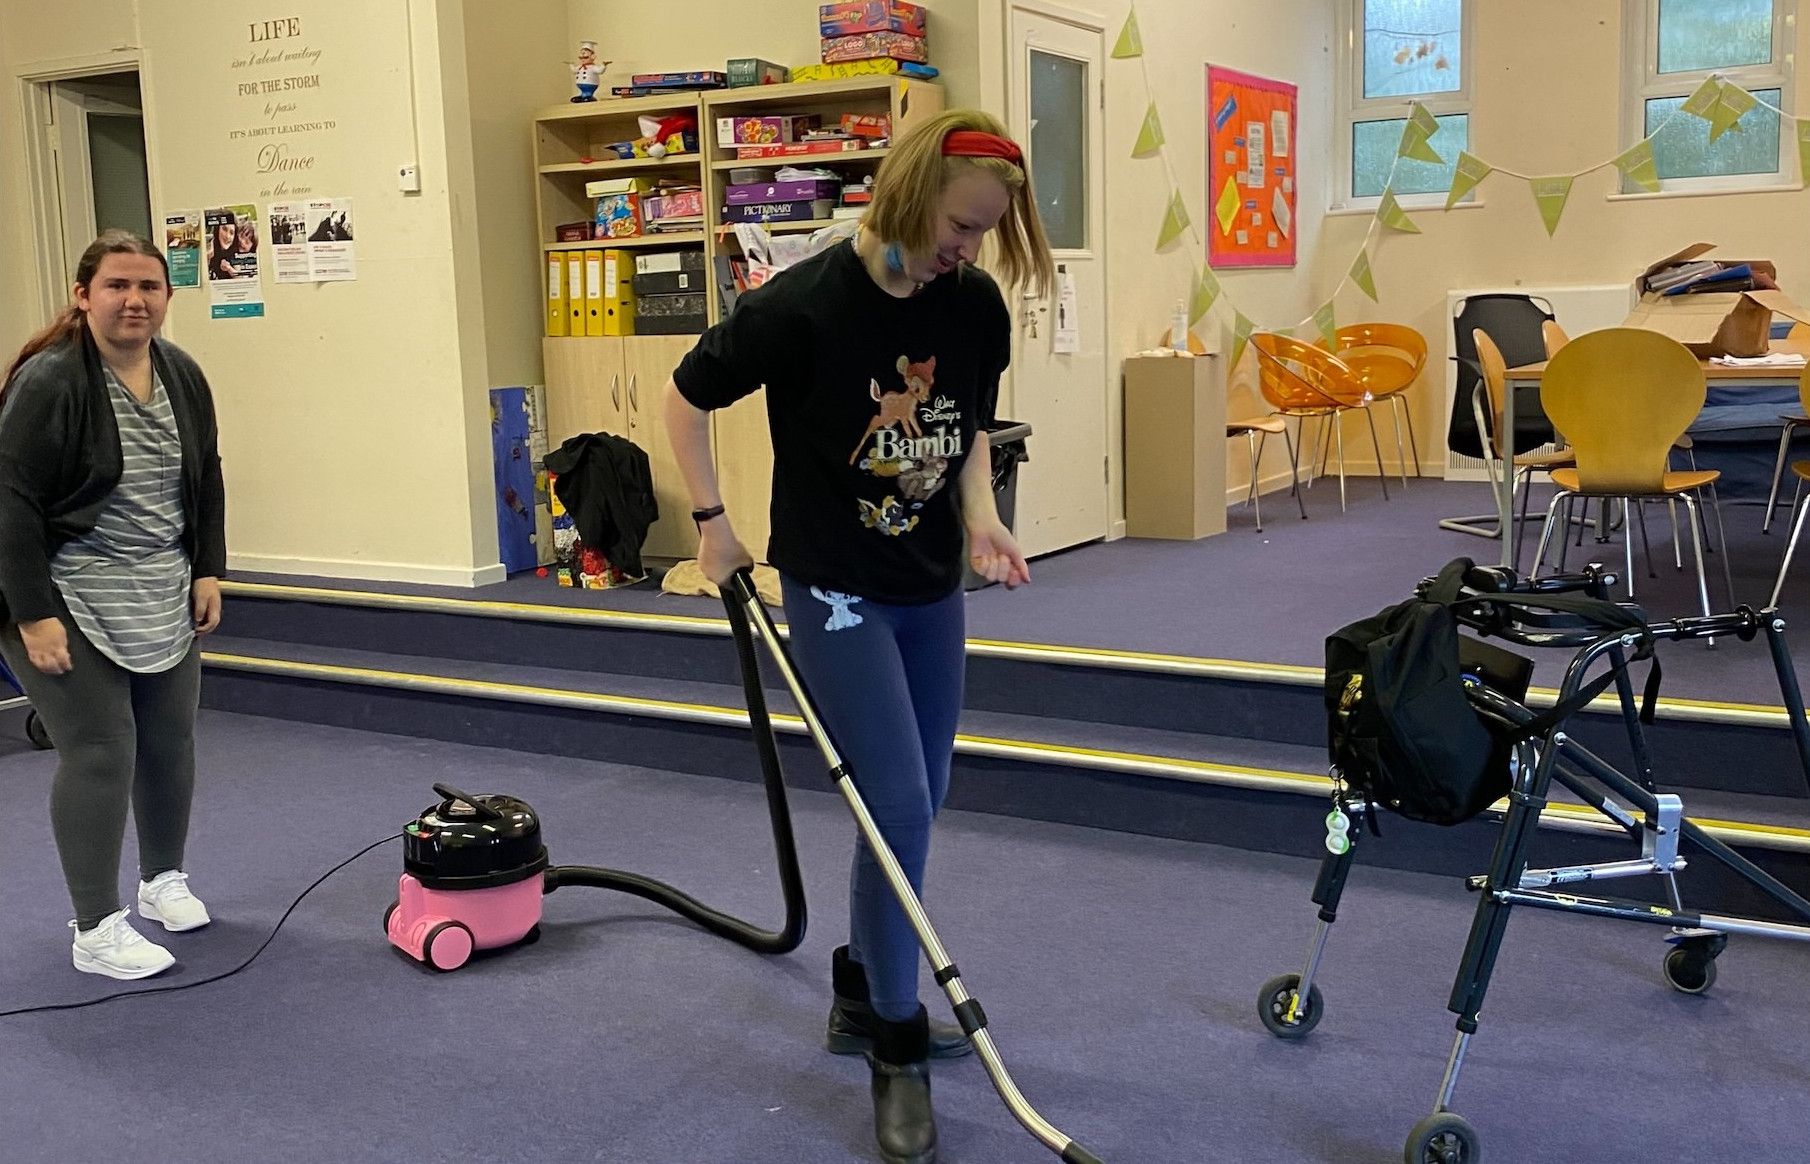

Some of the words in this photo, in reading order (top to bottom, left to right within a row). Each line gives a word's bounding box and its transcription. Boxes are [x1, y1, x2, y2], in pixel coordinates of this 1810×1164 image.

[248, 17, 300, 42] LIFE
[256, 48, 285, 65] about
[284, 46, 322, 67] waiting
[238, 82, 259, 97] FOR
[260, 79, 282, 94] THE
[283, 75, 321, 91] STORM
[263, 101, 273, 116] to
[271, 102, 297, 121] pass
[229, 130, 247, 140] IT'S
[247, 126, 277, 138] ABOUT
[277, 121, 323, 135] LEARNING
[323, 120, 337, 130] TO
[256, 143, 314, 174] Dance
[259, 187, 271, 198] in
[273, 181, 288, 197] the
[743, 203, 793, 216] PICTIONARY
[934, 394, 956, 410] Walt
[919, 407, 962, 425] Disney's
[875, 426, 963, 460] Bambi
